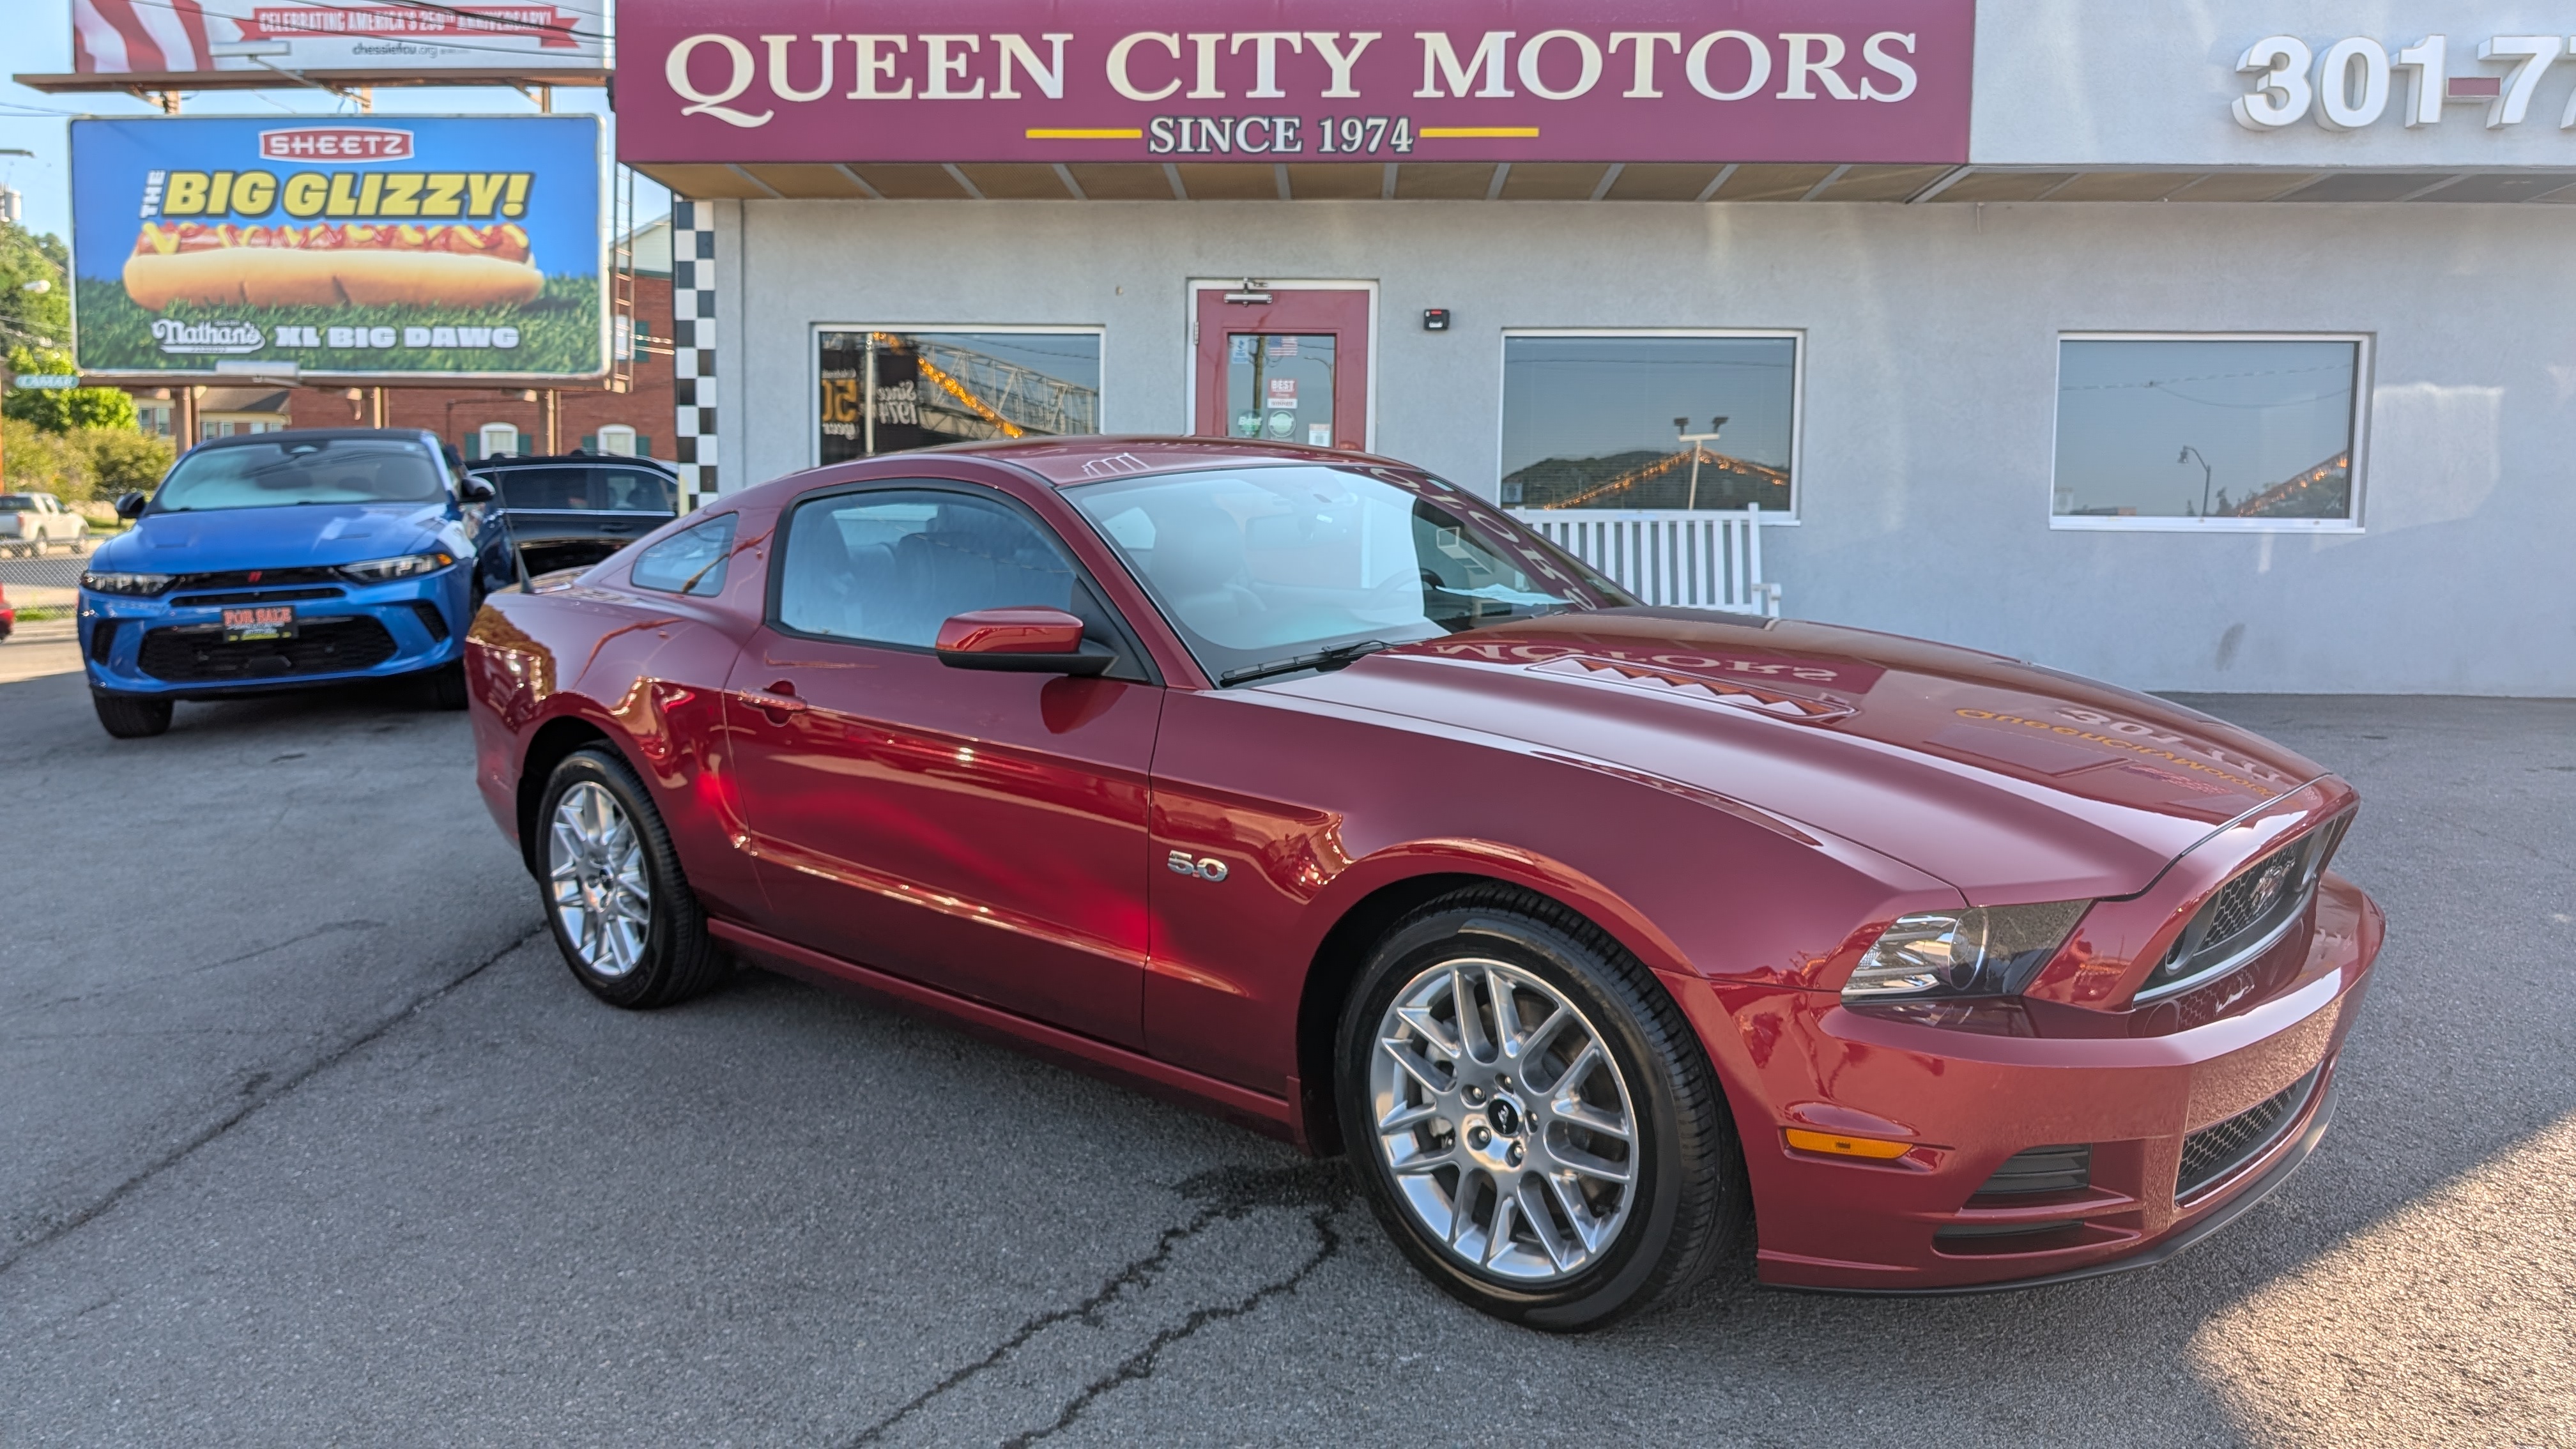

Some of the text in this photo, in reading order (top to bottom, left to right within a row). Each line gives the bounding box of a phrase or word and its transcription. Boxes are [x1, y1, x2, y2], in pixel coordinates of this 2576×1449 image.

[259, 11, 345, 32] CELEBRATING
[347, 10, 418, 31] AMERICA'S
[664, 29, 1918, 128] QUEEN CITY MOTORS
[2232, 34, 2576, 132] 301-7
[270, 135, 404, 156] SHEETZ
[1149, 116, 1414, 153] SINCE 1974
[141, 169, 167, 219] THE
[163, 170, 532, 218] BIG GLIZZY!
[151, 318, 262, 346] Nathan's
[275, 325, 520, 349] XL BIG DAWG
[224, 609, 255, 627] FOR
[255, 606, 293, 624] SALE
[1167, 850, 1230, 882] 5.0
